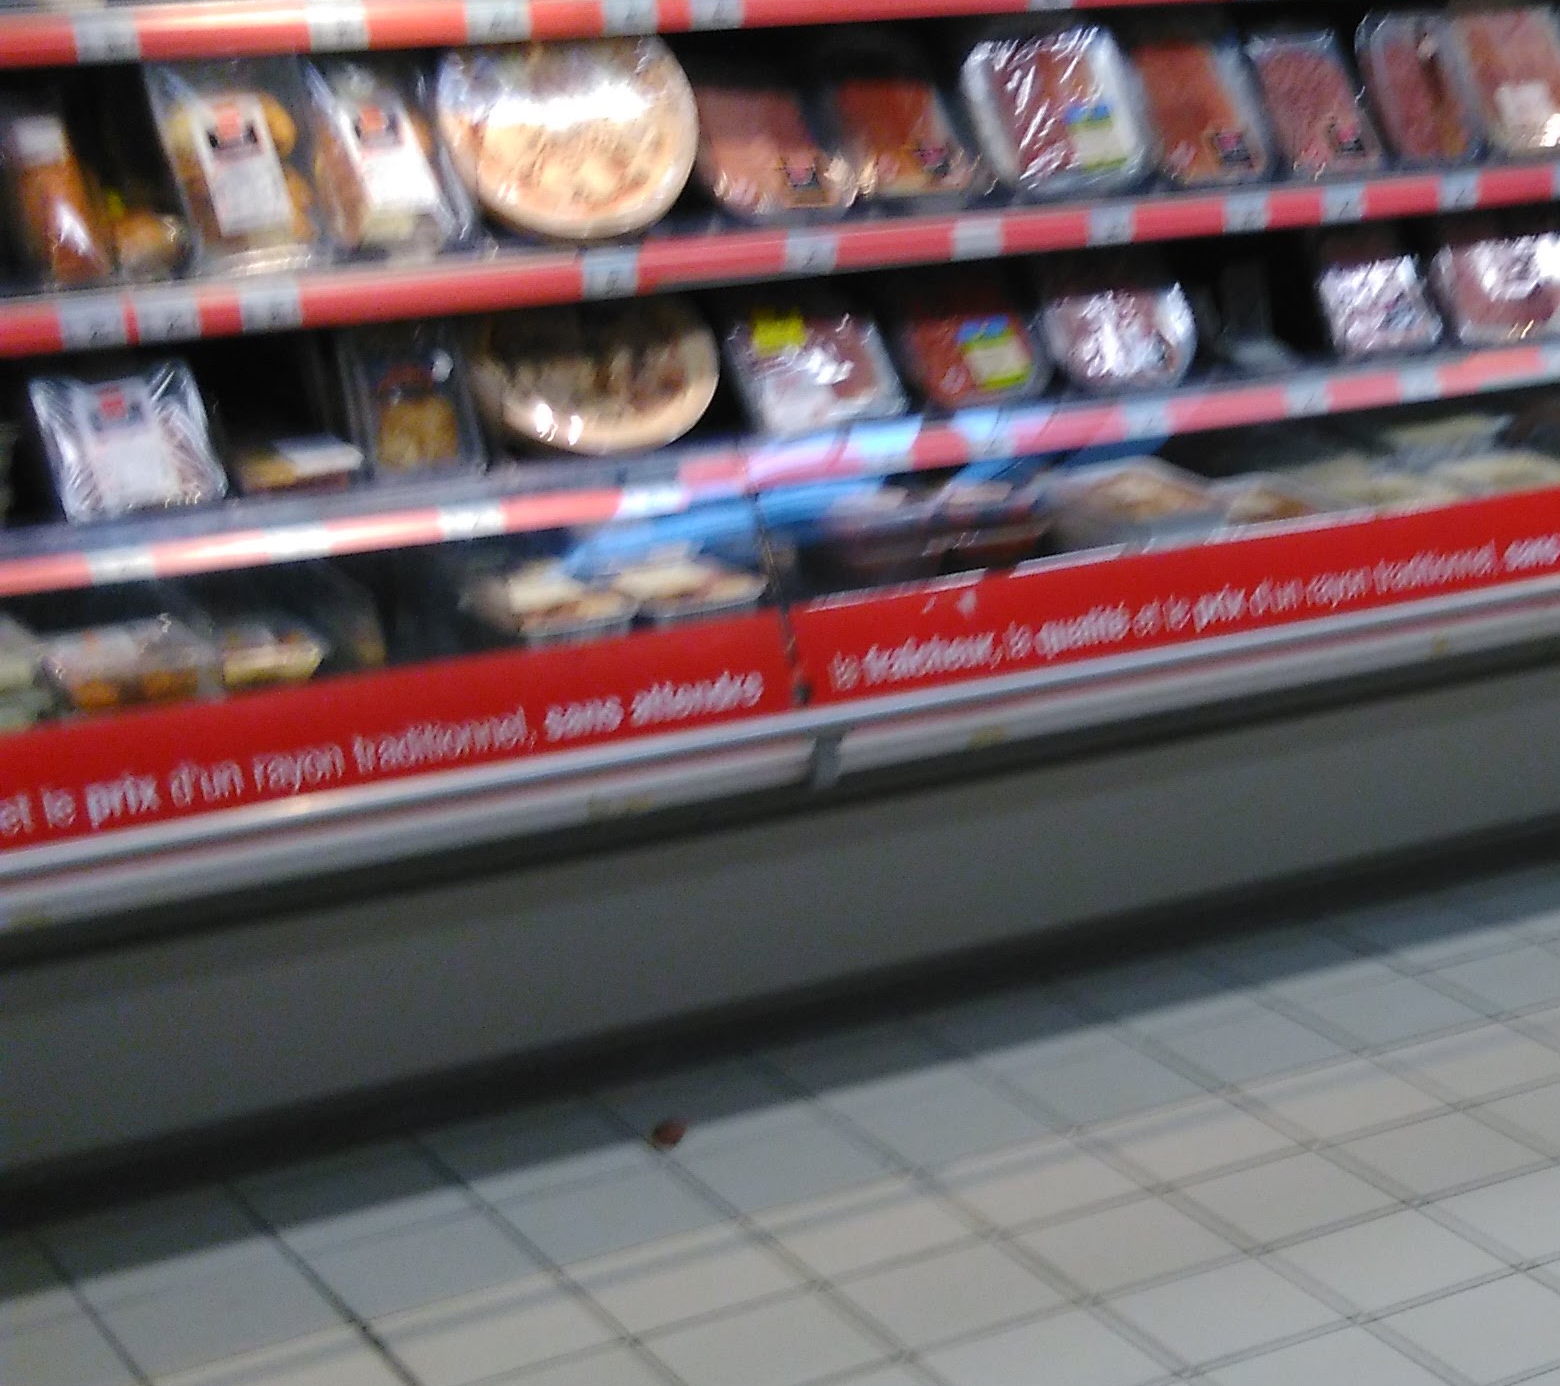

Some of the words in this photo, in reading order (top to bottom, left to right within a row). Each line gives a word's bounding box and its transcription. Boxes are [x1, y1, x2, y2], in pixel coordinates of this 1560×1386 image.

[42, 786, 76, 828] le
[85, 773, 160, 829] prix
[169, 761, 244, 807] d'un
[253, 743, 344, 793] rayon
[544, 695, 623, 743] sans
[630, 669, 764, 727] attendre
